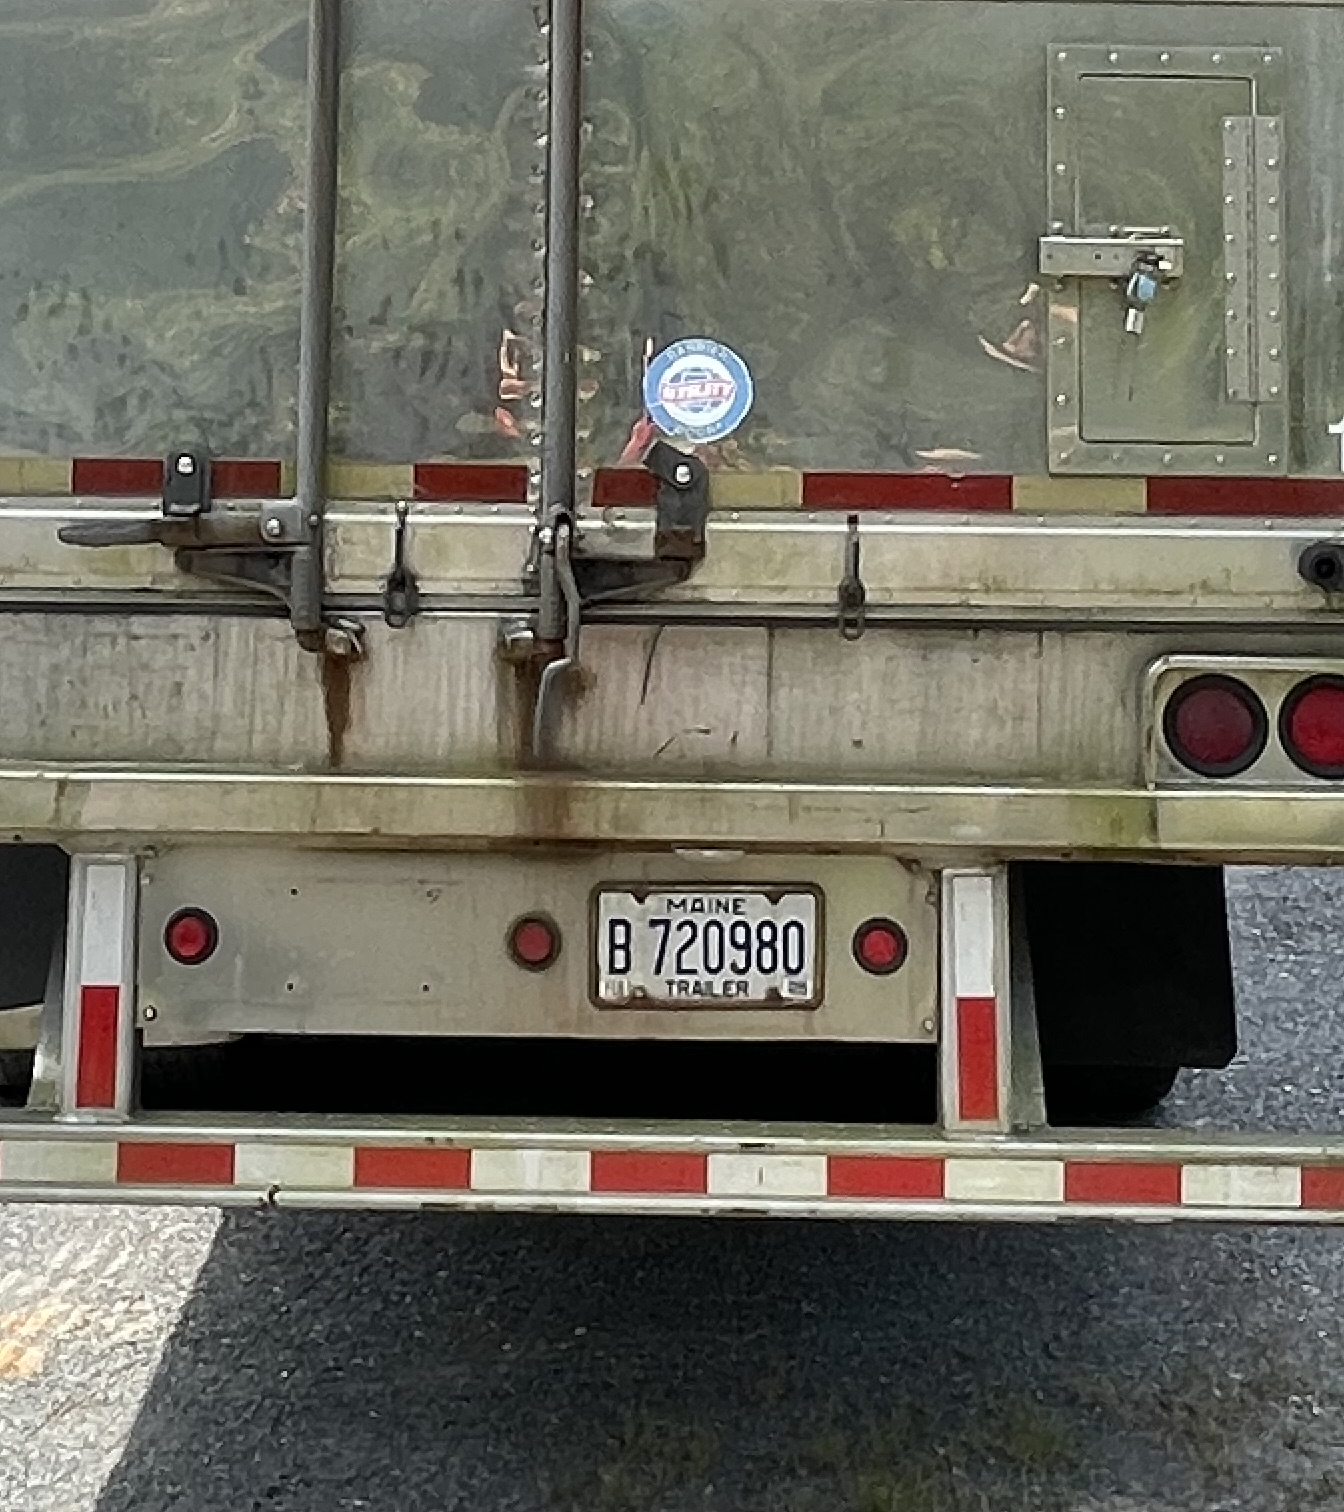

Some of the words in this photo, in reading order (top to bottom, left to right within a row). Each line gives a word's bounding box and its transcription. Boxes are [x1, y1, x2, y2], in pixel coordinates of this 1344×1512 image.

[666, 897, 747, 916] MAINE
[607, 918, 632, 976] B
[648, 918, 806, 977] 720980
[664, 979, 750, 997] TRAILER
